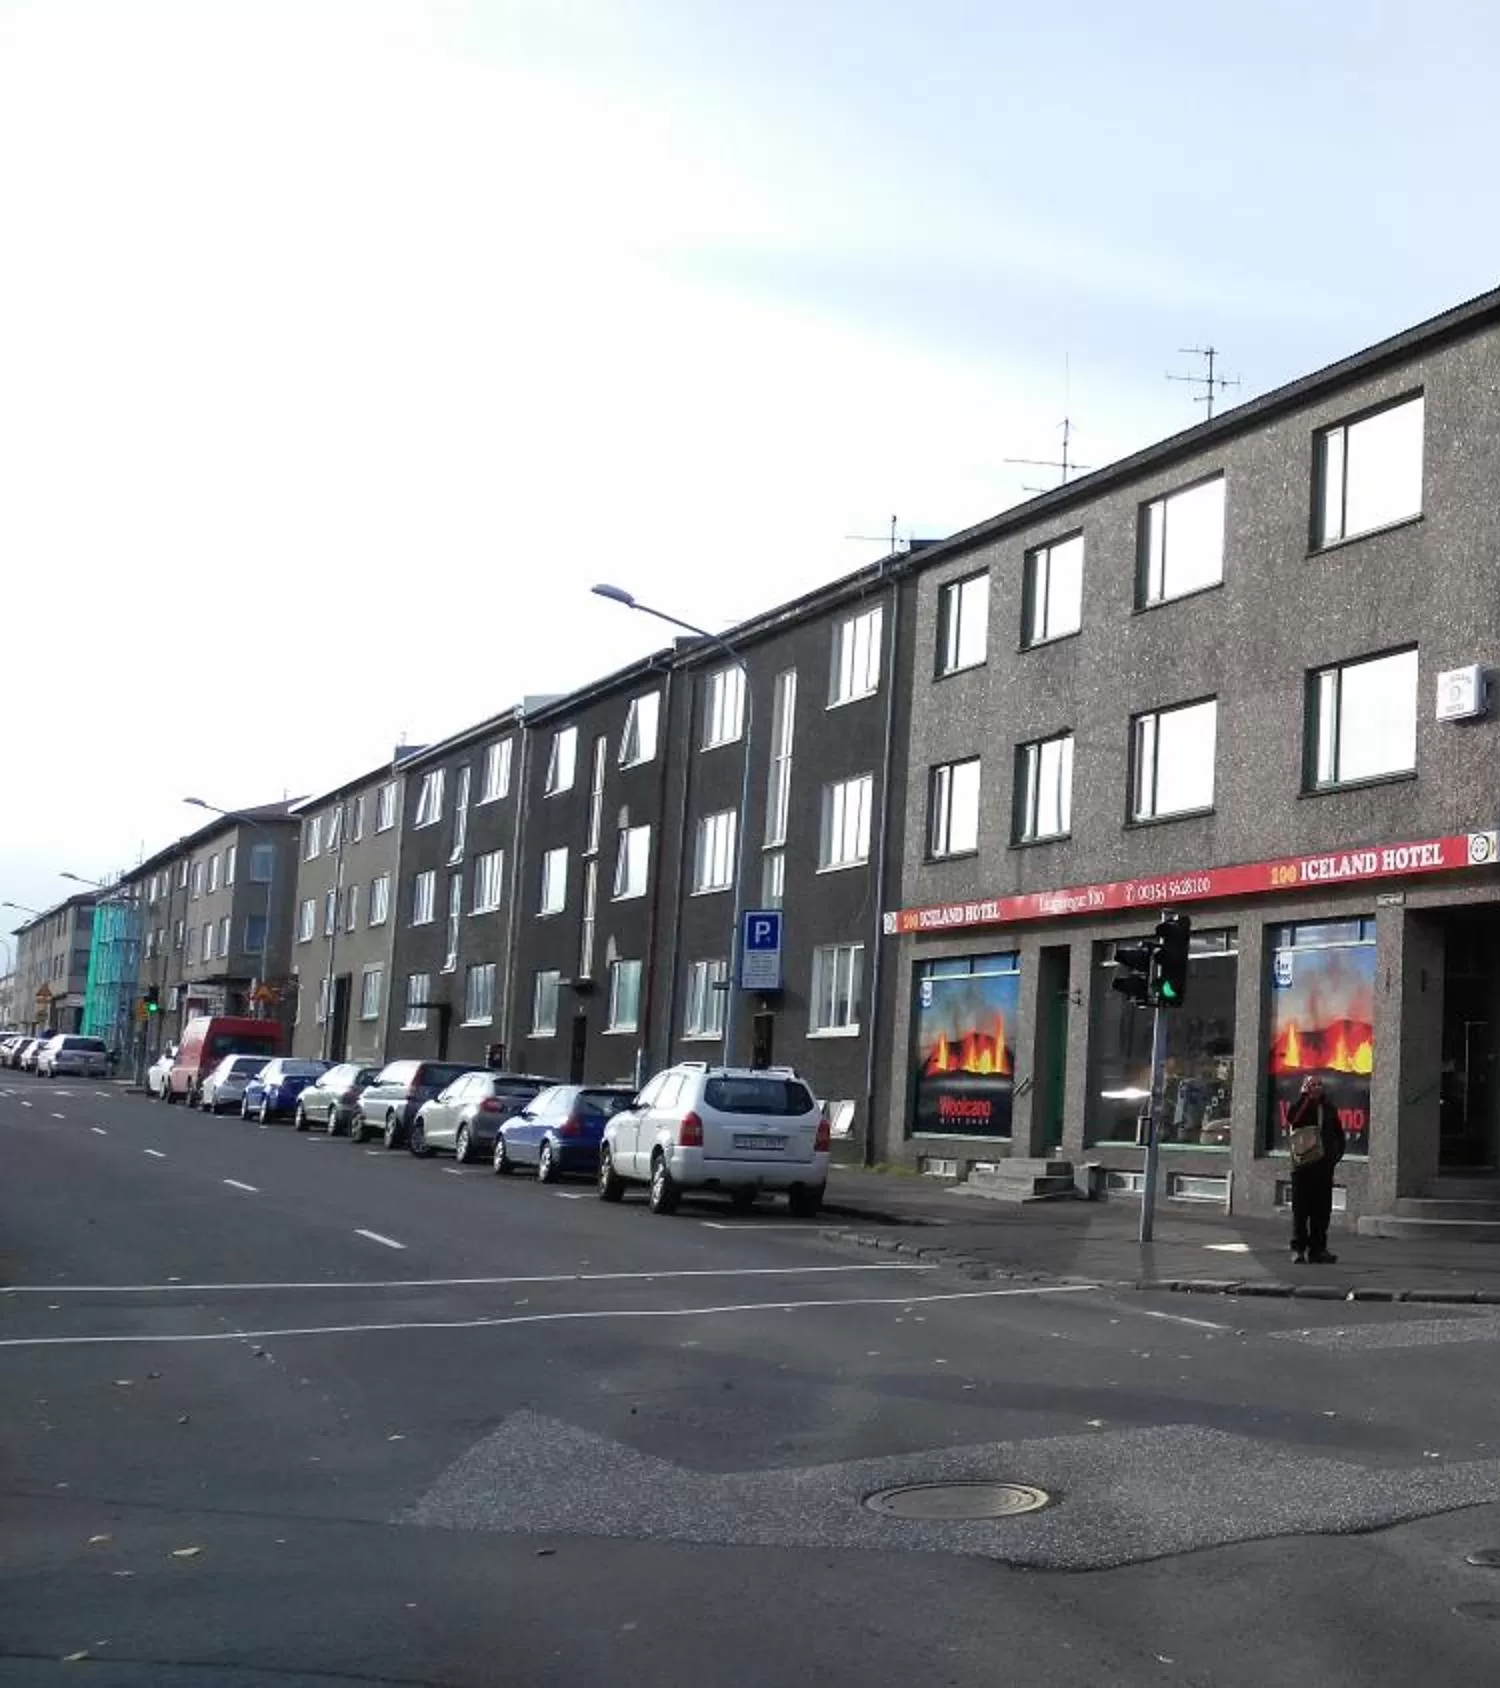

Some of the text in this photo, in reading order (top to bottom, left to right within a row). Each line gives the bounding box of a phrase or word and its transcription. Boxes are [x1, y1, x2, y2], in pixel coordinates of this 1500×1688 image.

[1271, 843, 1444, 884] 100 ICELAND HOTEL
[919, 907, 964, 928] ICELAND
[965, 901, 1000, 922] HOTEL
[755, 921, 771, 944] P
